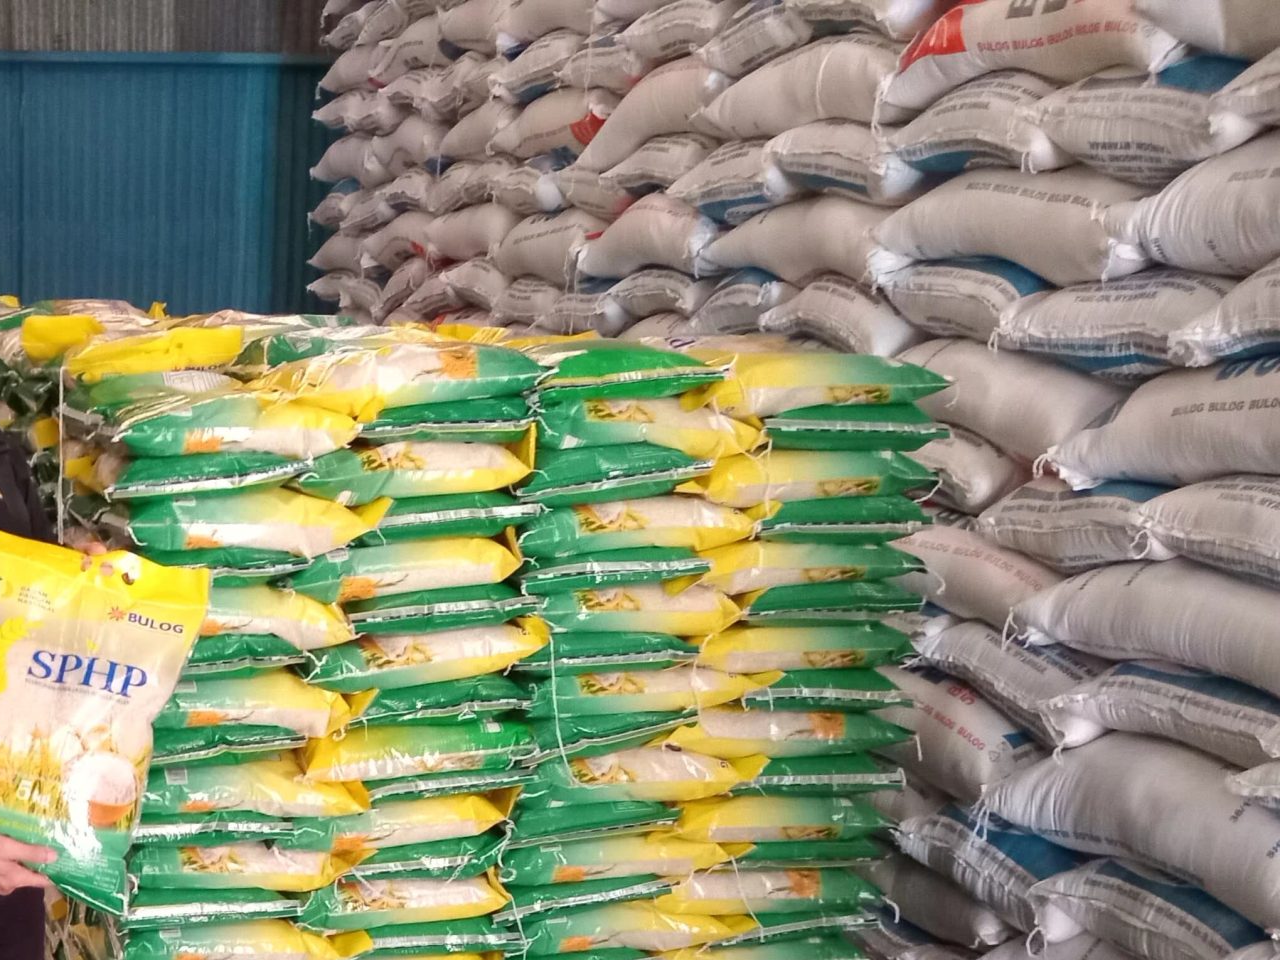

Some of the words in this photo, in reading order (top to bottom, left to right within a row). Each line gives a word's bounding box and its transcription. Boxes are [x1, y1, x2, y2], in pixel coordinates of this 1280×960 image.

[976, 40, 1010, 52] BULOG
[1011, 37, 1044, 50] BULOG
[1208, 400, 1245, 413] BULOG
[127, 612, 185, 635] BULOG
[26, 649, 149, 698] SPHP
[957, 726, 987, 752] BULOG
